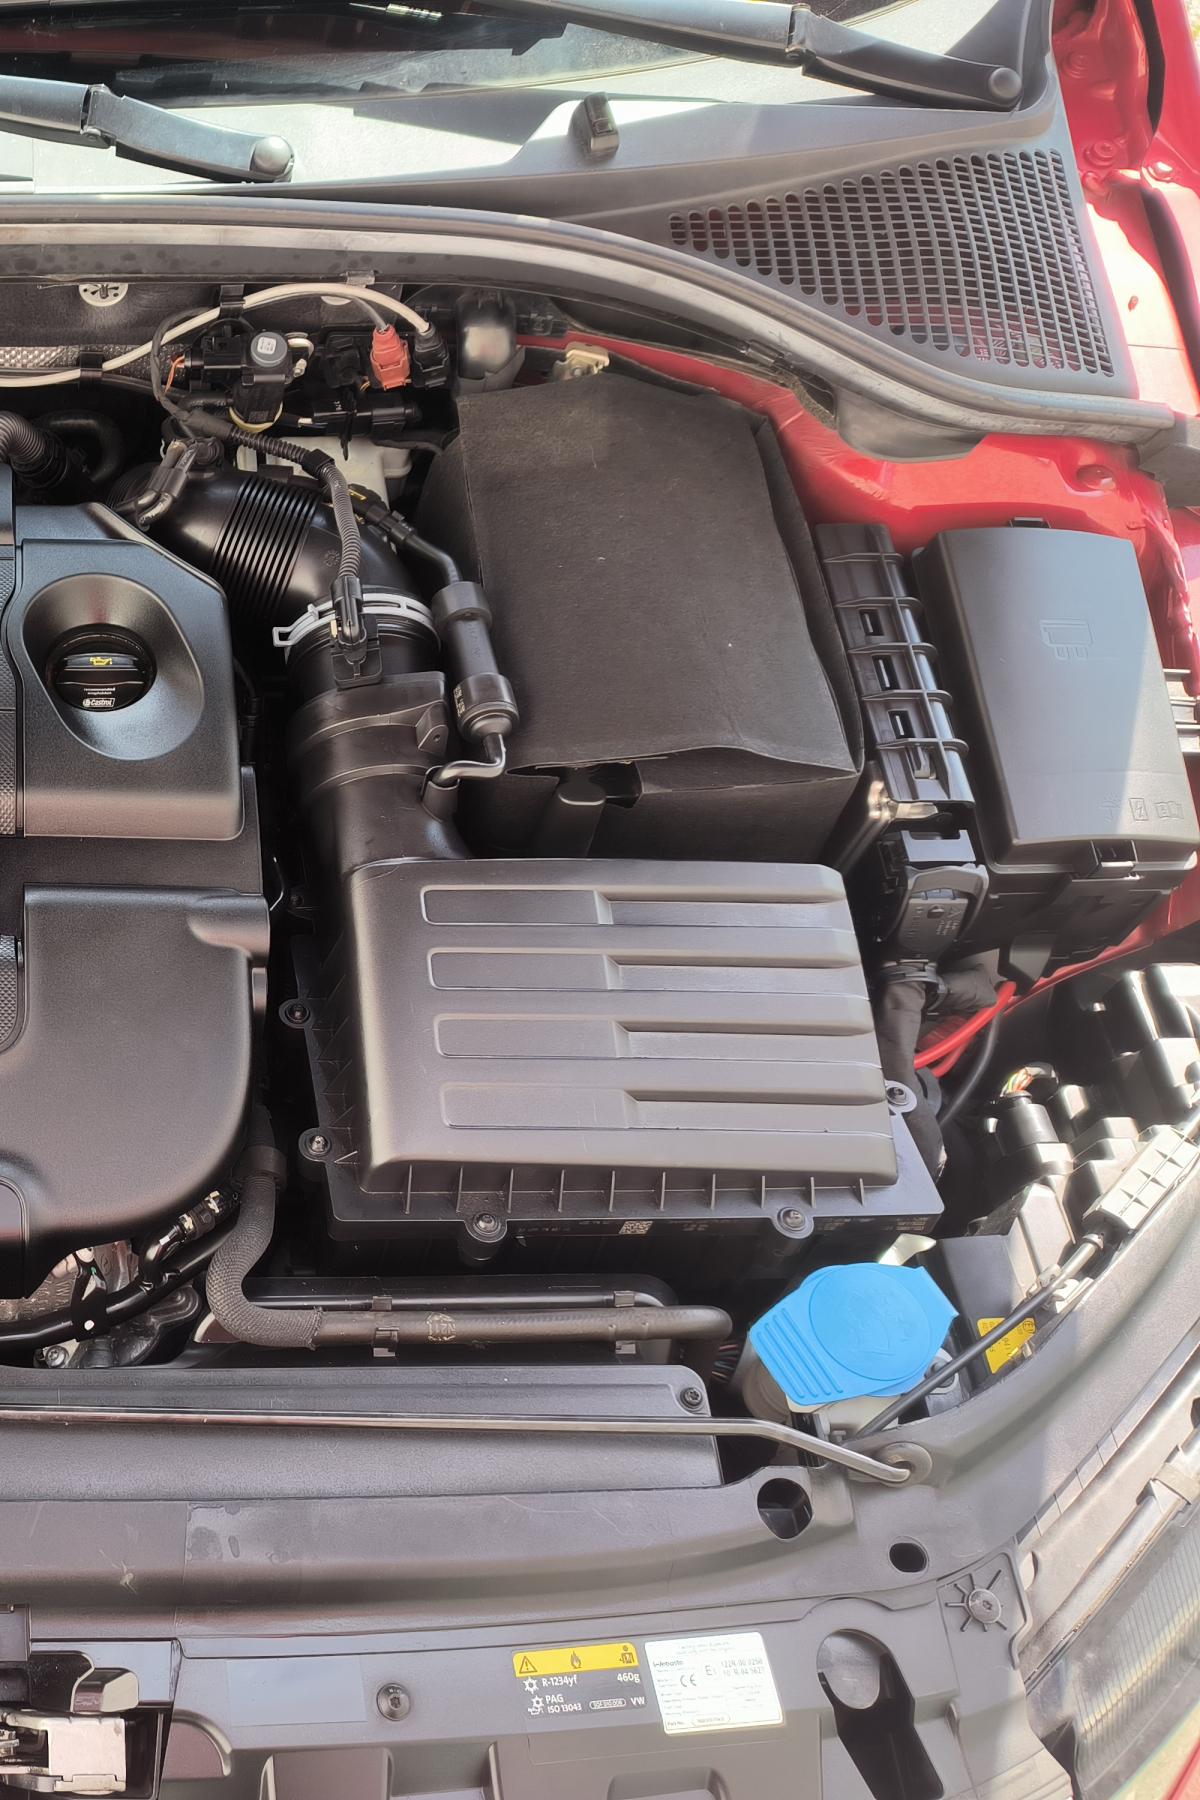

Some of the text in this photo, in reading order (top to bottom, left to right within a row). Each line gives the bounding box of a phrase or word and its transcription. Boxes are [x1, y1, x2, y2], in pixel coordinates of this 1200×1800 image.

[541, 1672, 641, 1687] R-1234yf 460g
[544, 1693, 564, 1705] PAG
[547, 1704, 560, 1714] ISO
[561, 1702, 582, 1713] 13043
[630, 1696, 646, 1707] VW
